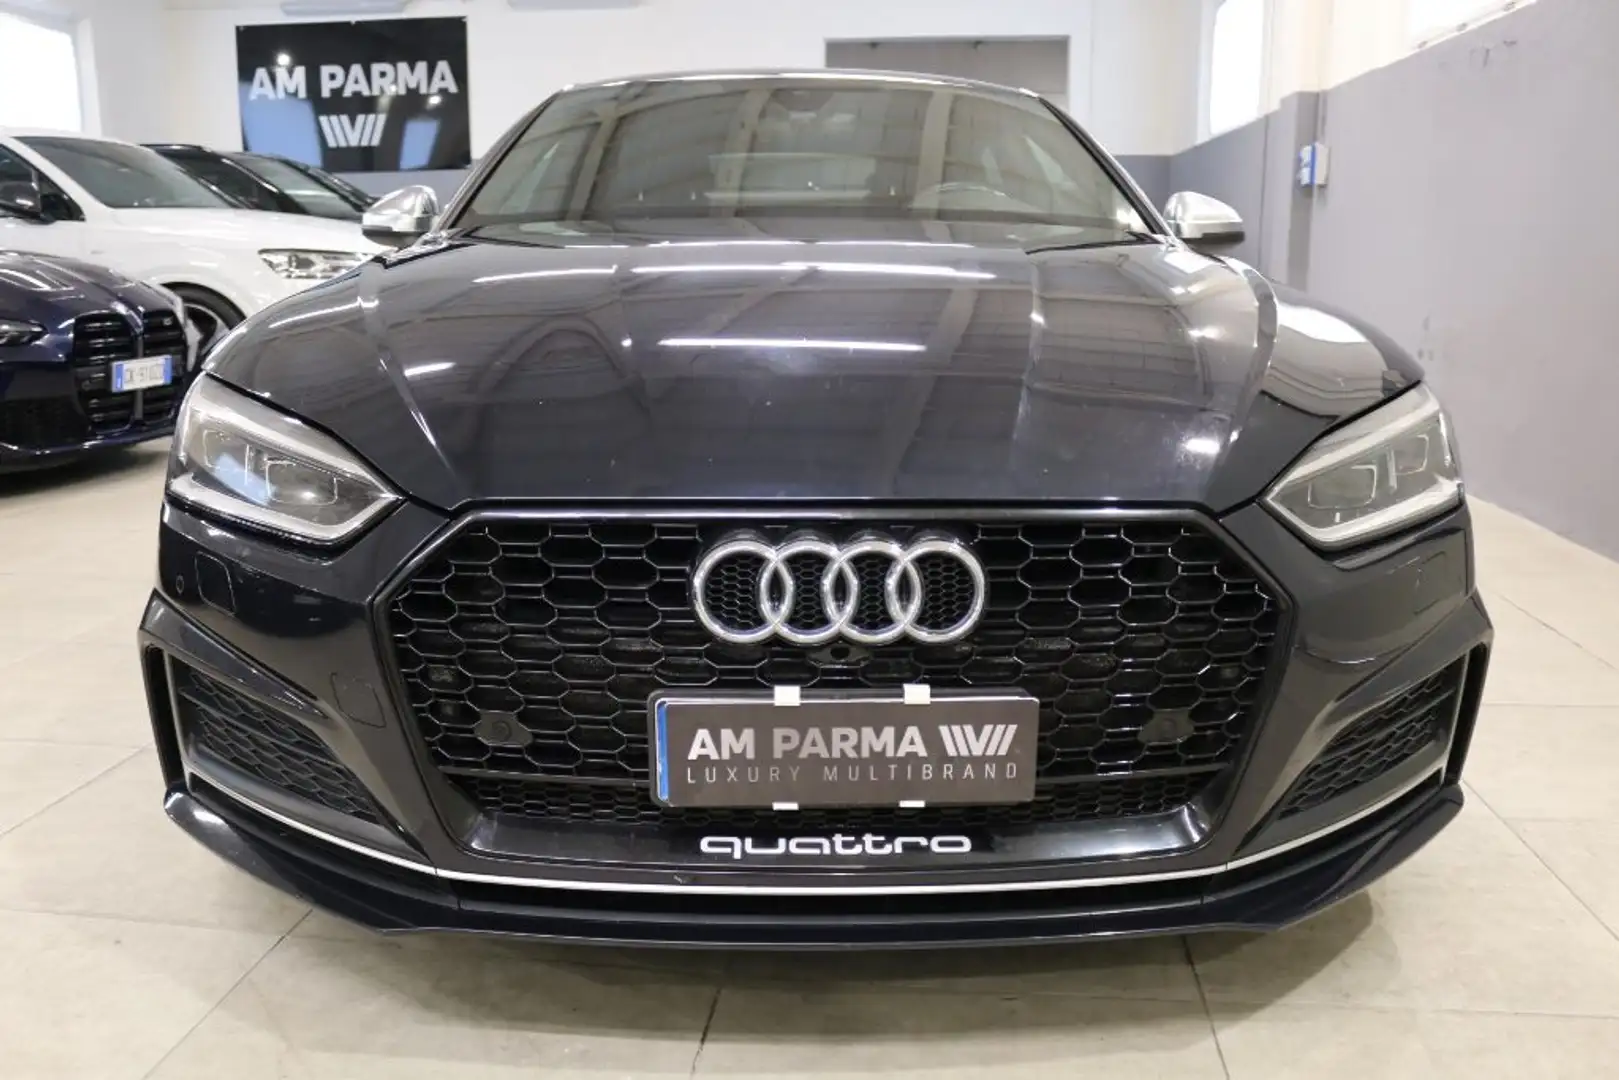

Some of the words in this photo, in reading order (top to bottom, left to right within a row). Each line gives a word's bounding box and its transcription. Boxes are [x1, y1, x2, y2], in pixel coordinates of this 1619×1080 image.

[250, 66, 307, 100] AM
[320, 60, 458, 98] PARMA
[687, 728, 755, 760] AM
[772, 725, 928, 759] PARMA
[687, 766, 800, 784] LUXURY
[823, 763, 1017, 782] MULTIBRAND
[700, 833, 972, 859] quattro
